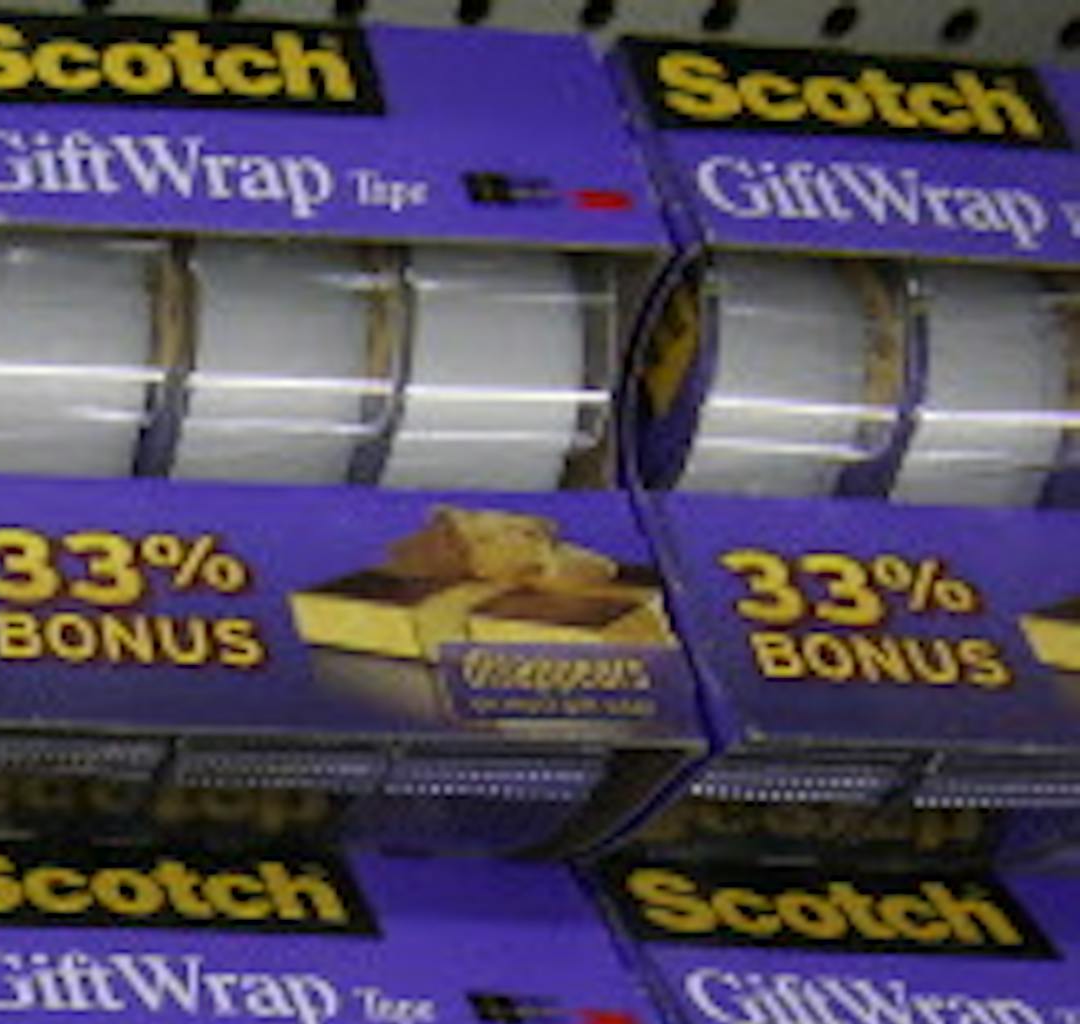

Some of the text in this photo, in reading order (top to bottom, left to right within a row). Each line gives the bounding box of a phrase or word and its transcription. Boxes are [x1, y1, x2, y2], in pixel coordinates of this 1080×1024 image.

[658, 53, 1042, 134] Scotch
[697, 156, 1047, 249] GiftWrap
[721, 550, 979, 626] 33%
[751, 632, 1011, 686] BONUS
[627, 869, 1021, 944] Scotch
